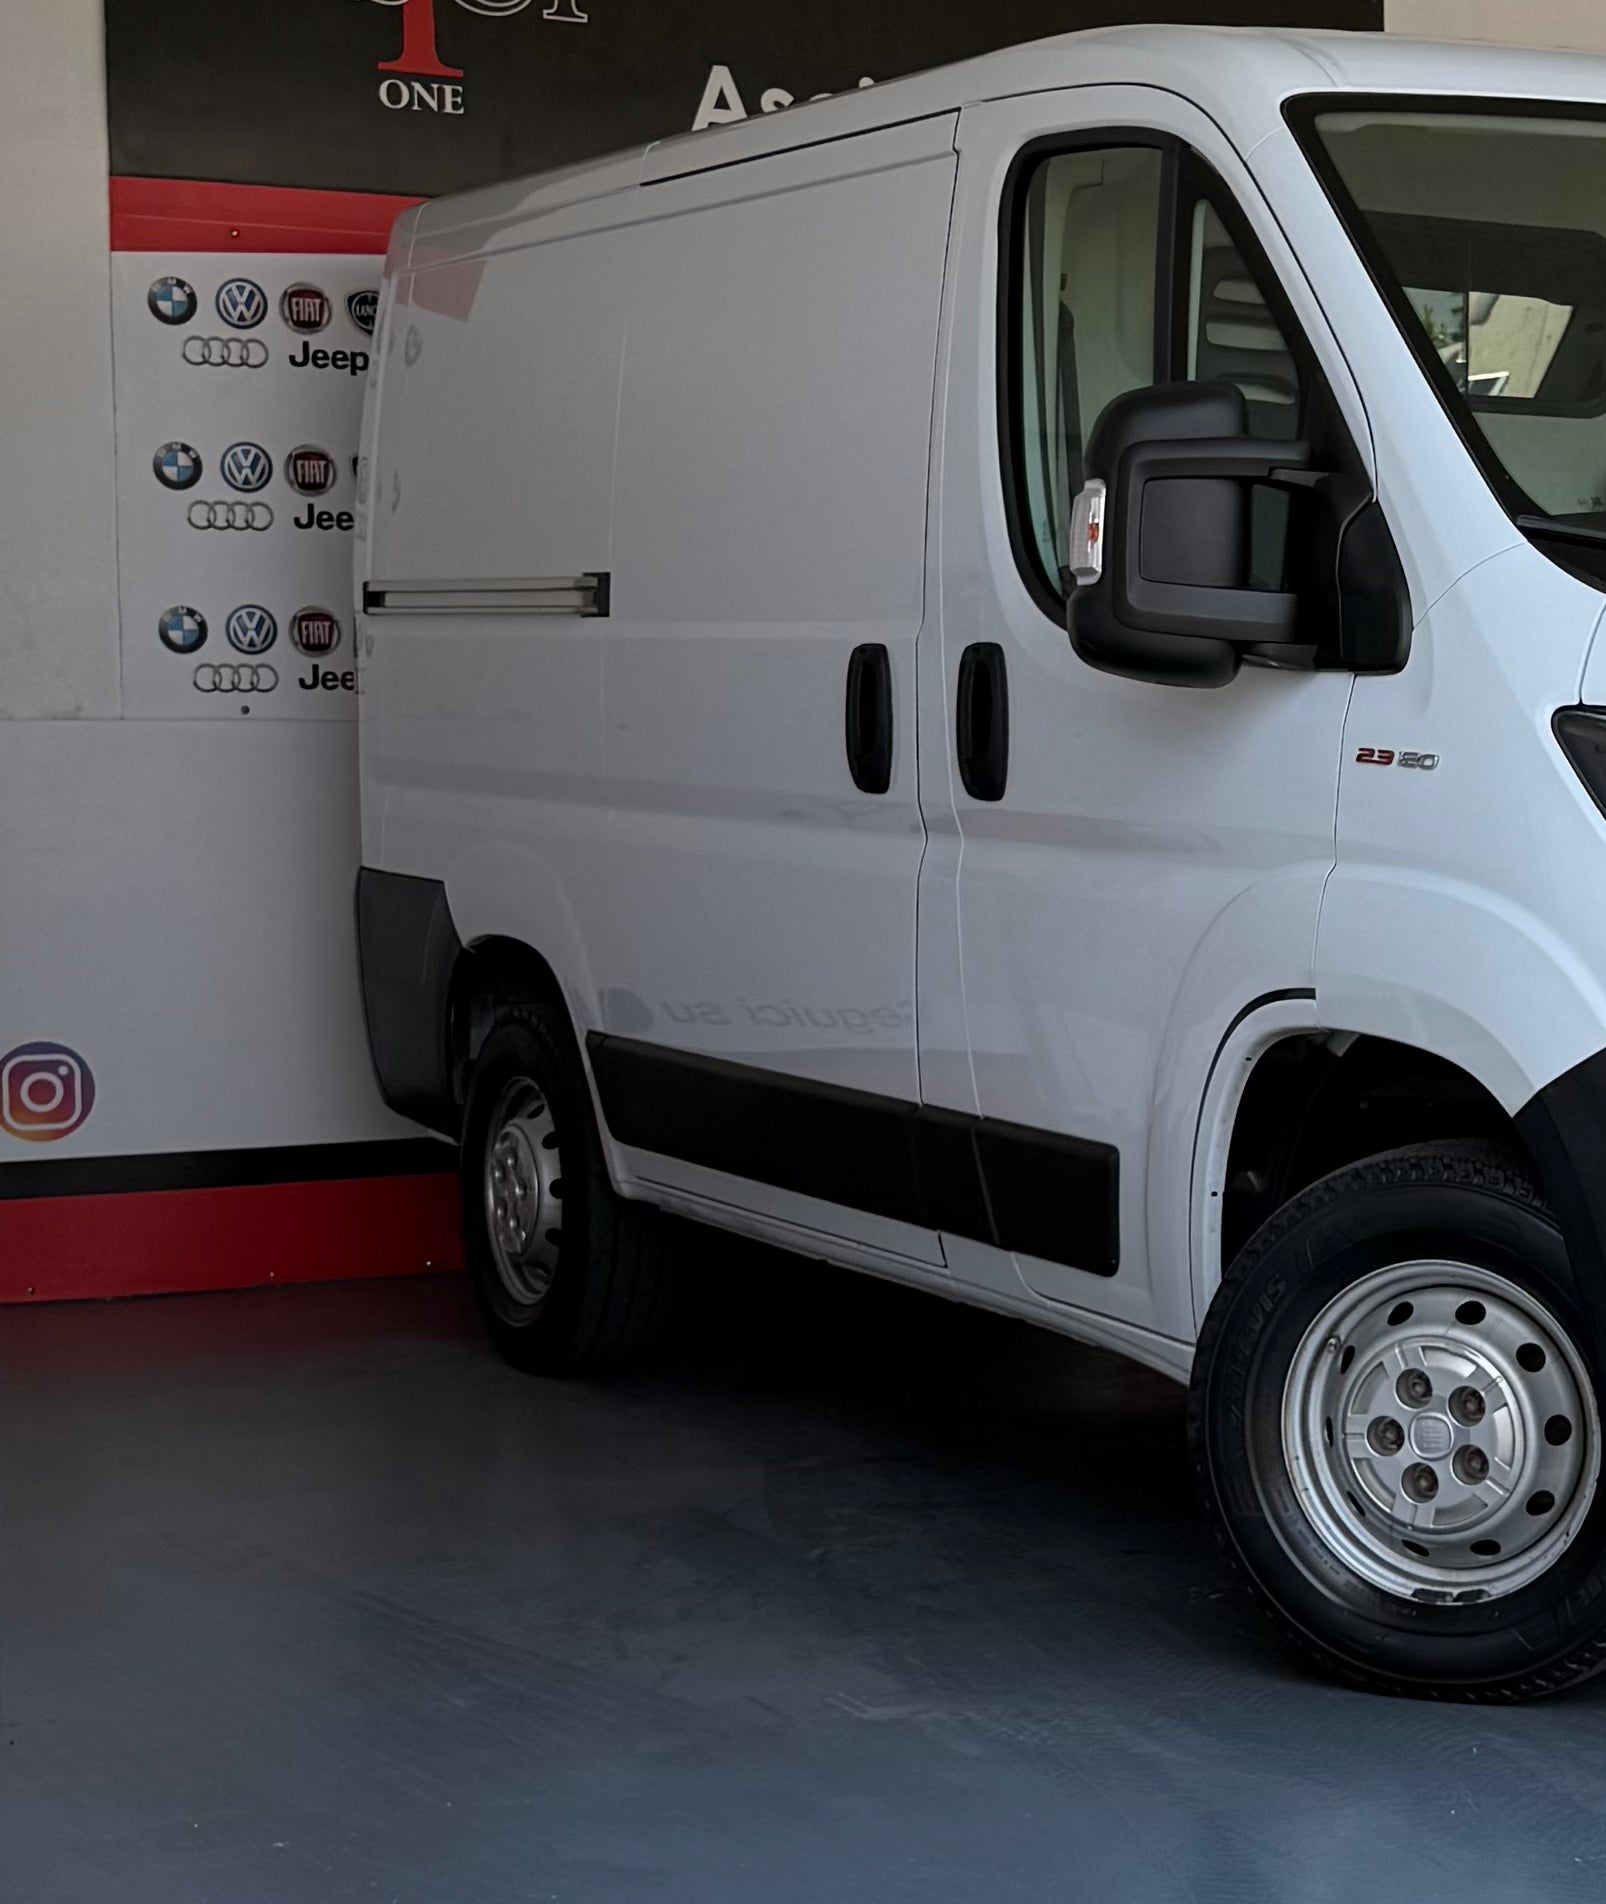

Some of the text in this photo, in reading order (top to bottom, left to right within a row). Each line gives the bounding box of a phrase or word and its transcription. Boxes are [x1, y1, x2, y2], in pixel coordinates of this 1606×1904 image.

[379, 78, 464, 116] ONE
[290, 296, 322, 322] FIAT
[289, 340, 370, 375] Jeep
[295, 459, 327, 484] FIAT
[293, 503, 355, 531] Jee
[301, 620, 331, 645] FIAT
[298, 663, 354, 691] Jee
